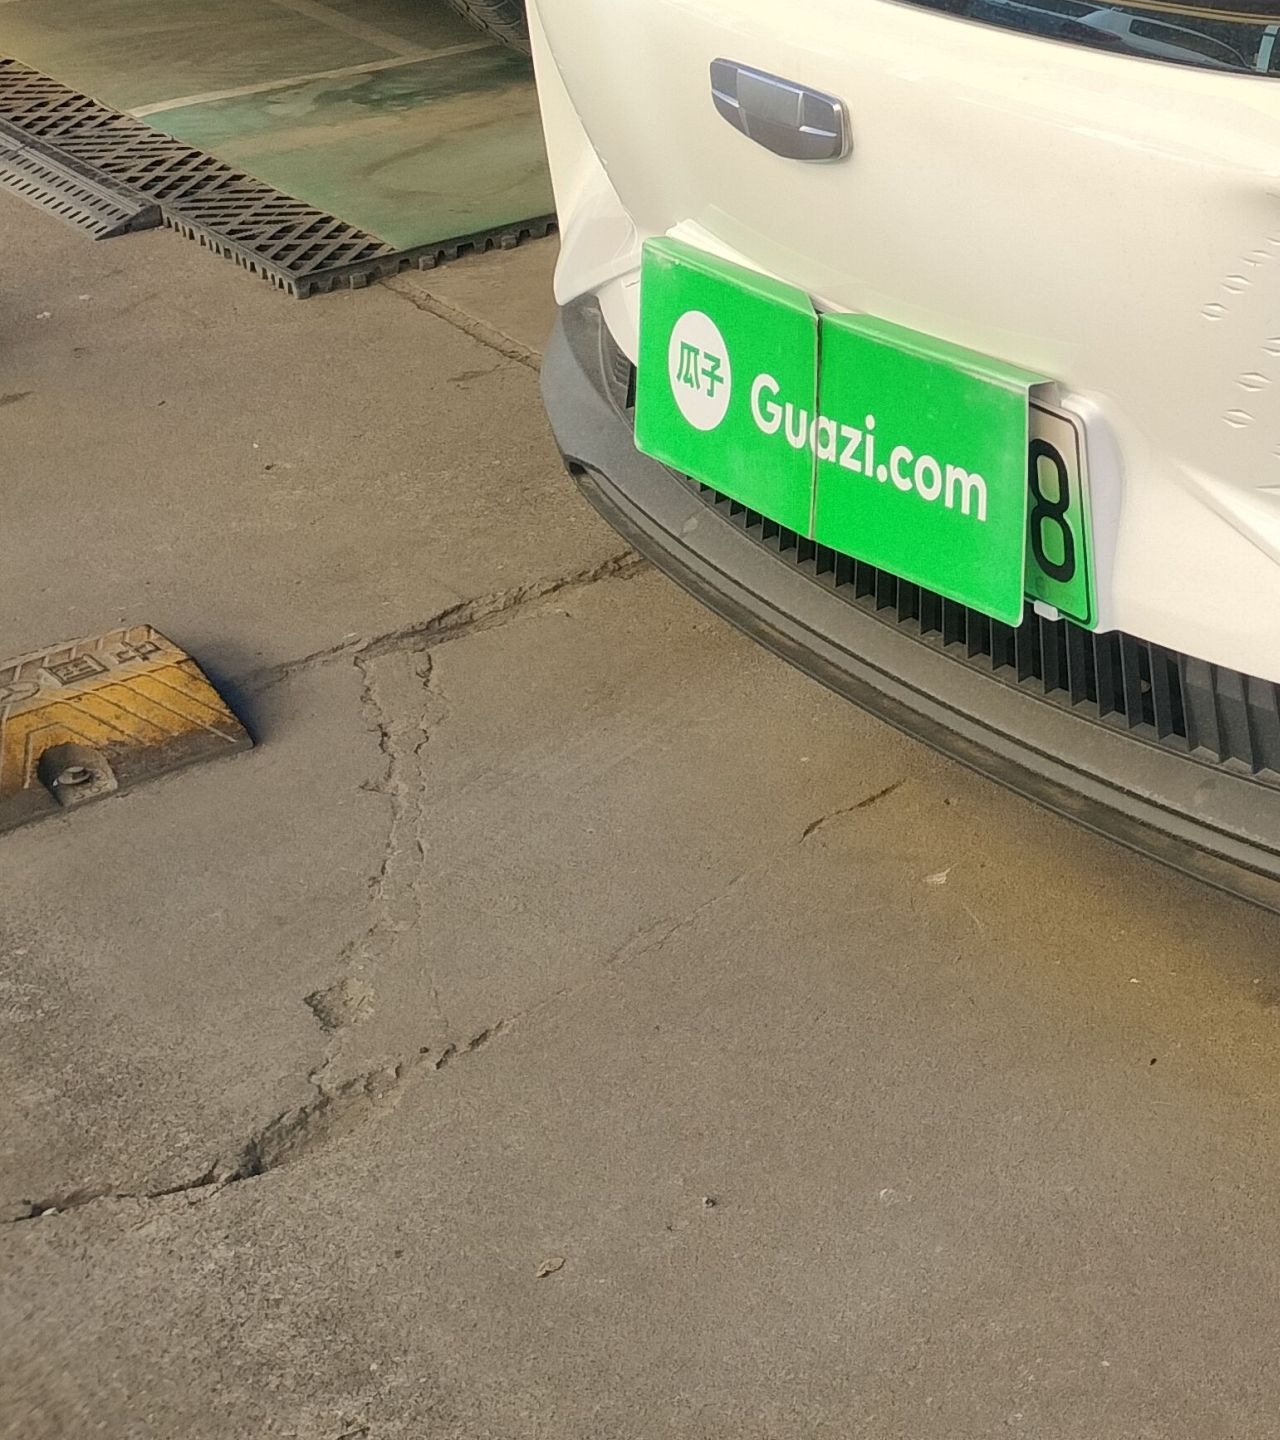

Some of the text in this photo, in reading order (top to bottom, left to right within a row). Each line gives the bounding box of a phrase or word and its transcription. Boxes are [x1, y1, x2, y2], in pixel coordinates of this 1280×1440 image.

[676, 340, 725, 398] 瓜子
[750, 373, 988, 522] Guazi.com
[1029, 438, 1075, 583] 8
